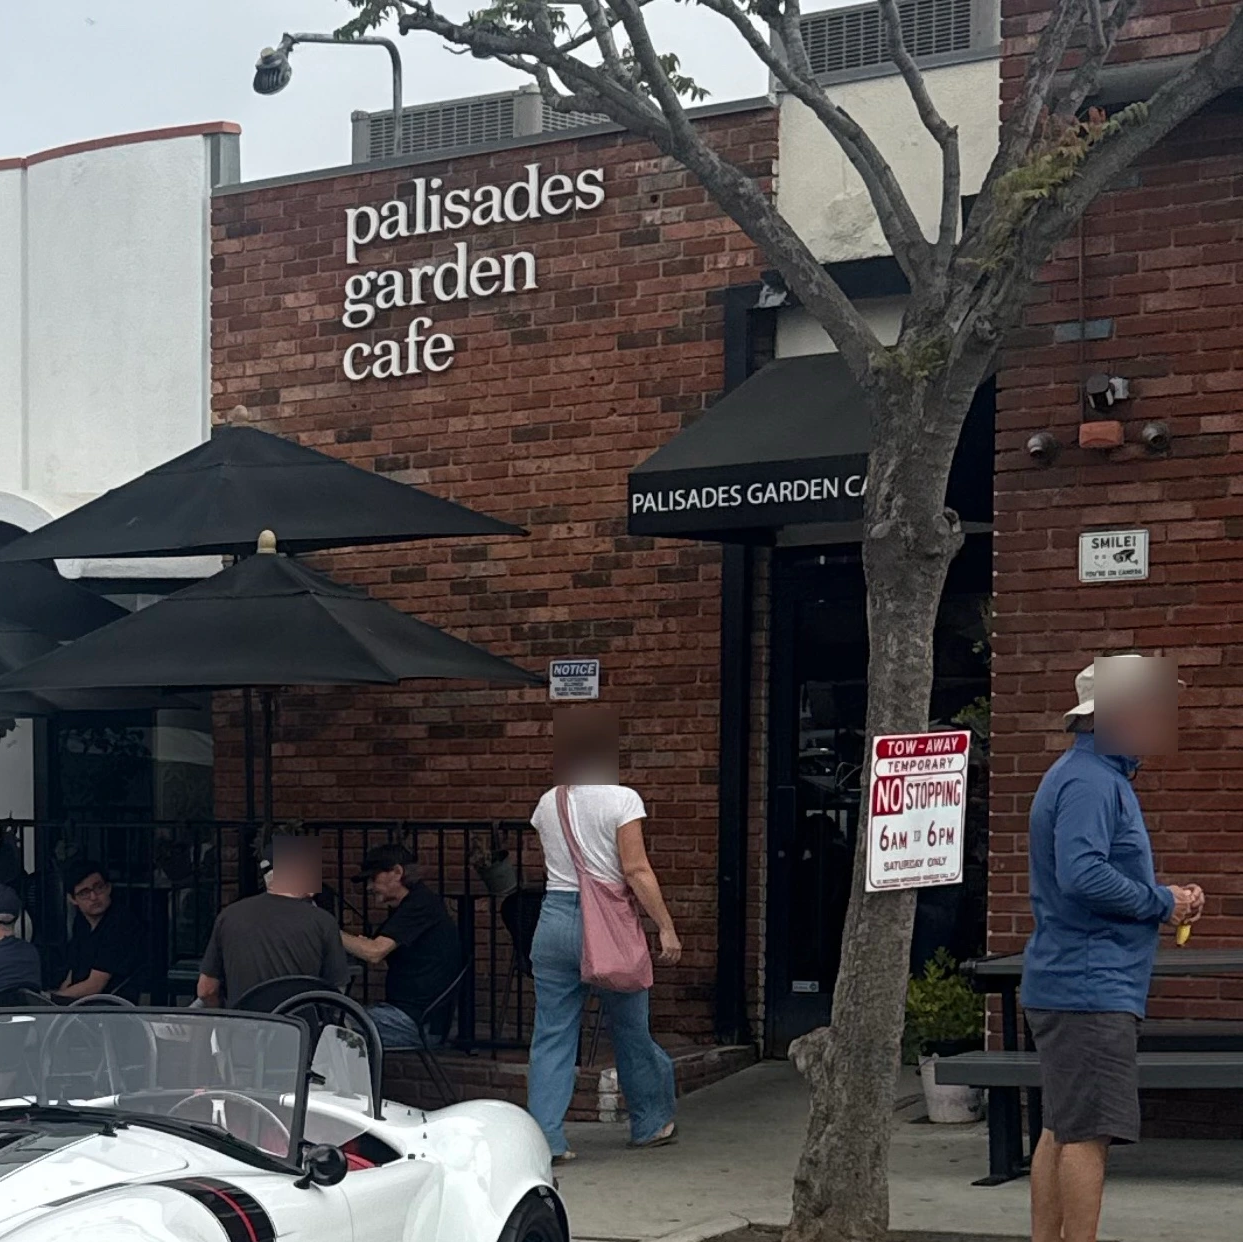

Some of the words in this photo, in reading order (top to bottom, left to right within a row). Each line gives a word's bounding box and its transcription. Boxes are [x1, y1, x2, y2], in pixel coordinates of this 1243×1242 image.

[345, 163, 605, 264] palisades
[342, 242, 539, 328] garden
[343, 317, 455, 380] cafe
[632, 484, 742, 514] PALISADES
[747, 477, 839, 504] GARDEN
[1091, 535, 1137, 549] SMILE!
[554, 663, 595, 675] NOTICE
[887, 737, 959, 756] TOW-AWAY
[888, 757, 954, 773] TEMPORARY
[876, 778, 902, 813] NO
[906, 779, 961, 810] STOPPING
[883, 858, 924, 872] SATURDAY
[927, 856, 947, 868] ONLY
